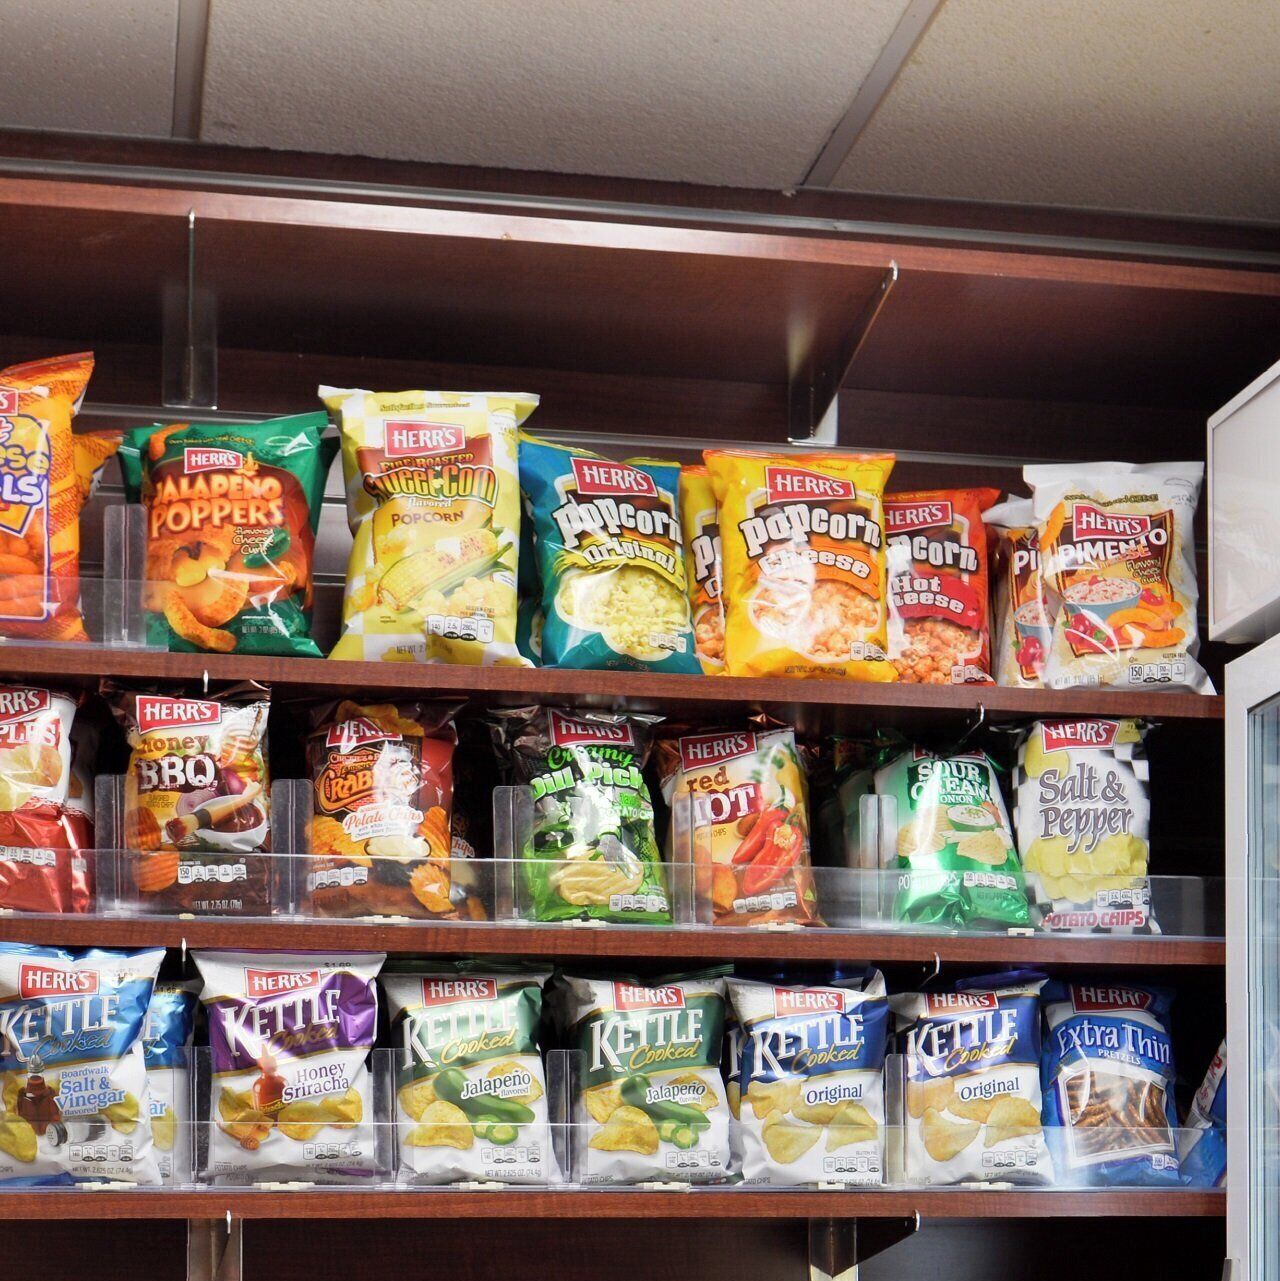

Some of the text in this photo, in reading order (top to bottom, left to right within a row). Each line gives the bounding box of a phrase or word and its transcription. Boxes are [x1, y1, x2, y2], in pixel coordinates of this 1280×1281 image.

[392, 428, 457, 449] HERR'S
[380, 453, 474, 473] FIRE ROASTED
[151, 499, 286, 536] POPPERS
[391, 510, 464, 527] POPCORN
[552, 497, 682, 550] popcorn
[740, 502, 882, 559] popcorn
[582, 537, 676, 575] Original
[1058, 527, 1168, 566] PIMENTO
[144, 701, 213, 722] HERR'S
[687, 737, 748, 760] HERR'S
[686, 765, 730, 792] red
[1039, 763, 1127, 805] Salt &
[1040, 806, 1132, 852] Pepper
[1044, 910, 1145, 928] POTATO CHIPS
[441, 1029, 516, 1064] Cooked
[1057, 1020, 1170, 1064] Extra Thin
[792, 1044, 860, 1073] Cooked
[1098, 1048, 1141, 1065] PRETZELS
[60, 1076, 111, 1094] Salt &
[61, 1066, 110, 1080] Boardwalk
[296, 1062, 346, 1084] Honey
[461, 1068, 531, 1098] Jalapeño
[55, 1089, 126, 1110] Vinegar
[283, 1075, 350, 1103] Sriracha
[805, 1084, 863, 1105] Original
[960, 1077, 1020, 1101] Original
[63, 1105, 98, 1116] flavored
